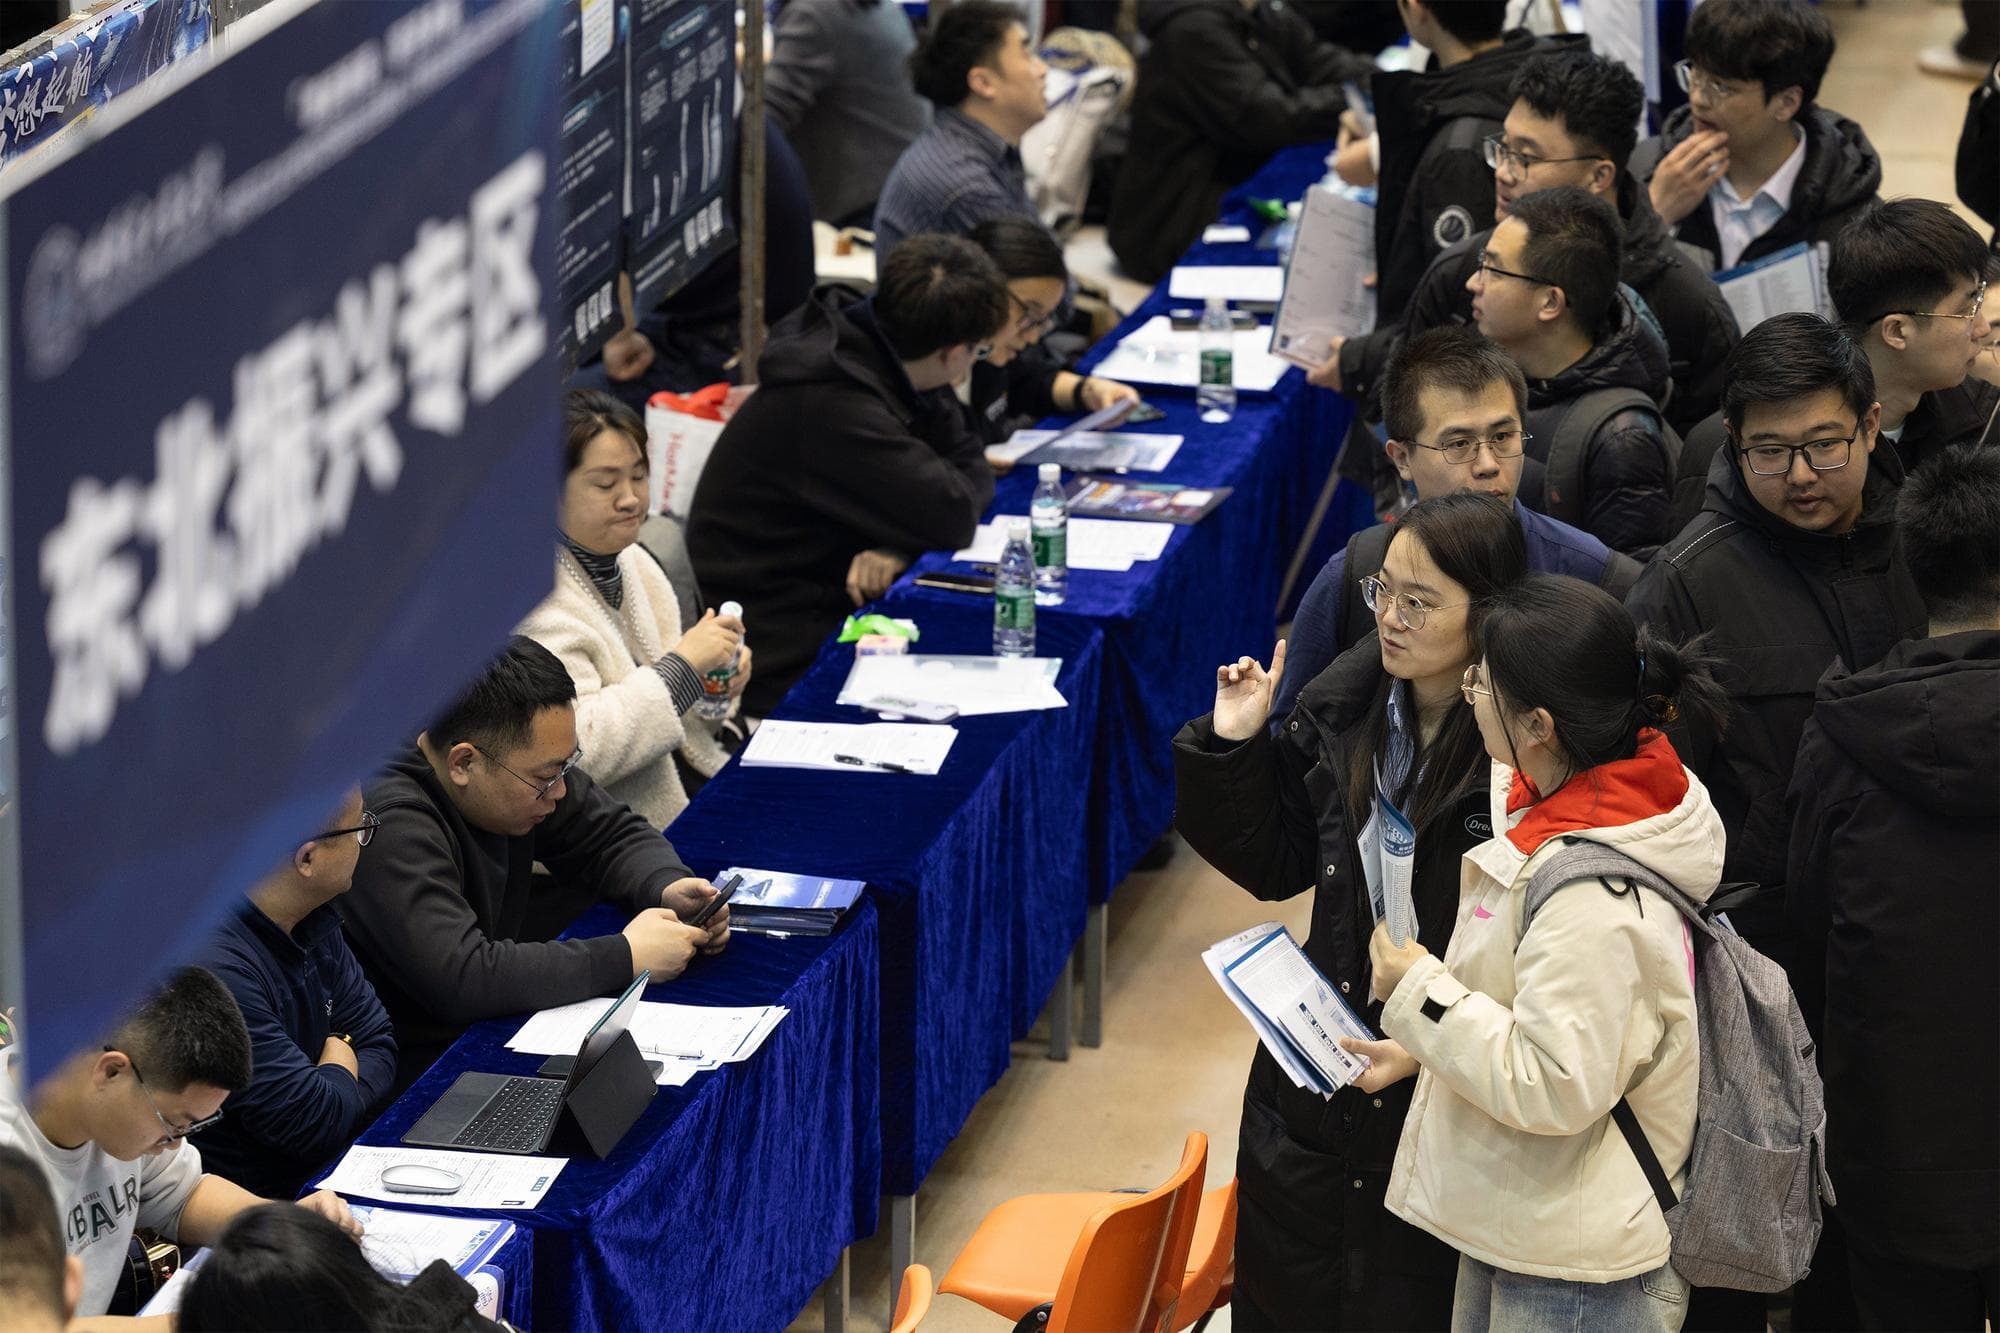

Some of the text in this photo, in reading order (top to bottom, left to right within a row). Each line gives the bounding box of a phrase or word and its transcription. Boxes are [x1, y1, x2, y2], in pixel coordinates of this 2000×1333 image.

[40, 149, 547, 757] 东北振兴专区
[1468, 819, 1491, 832] Dre
